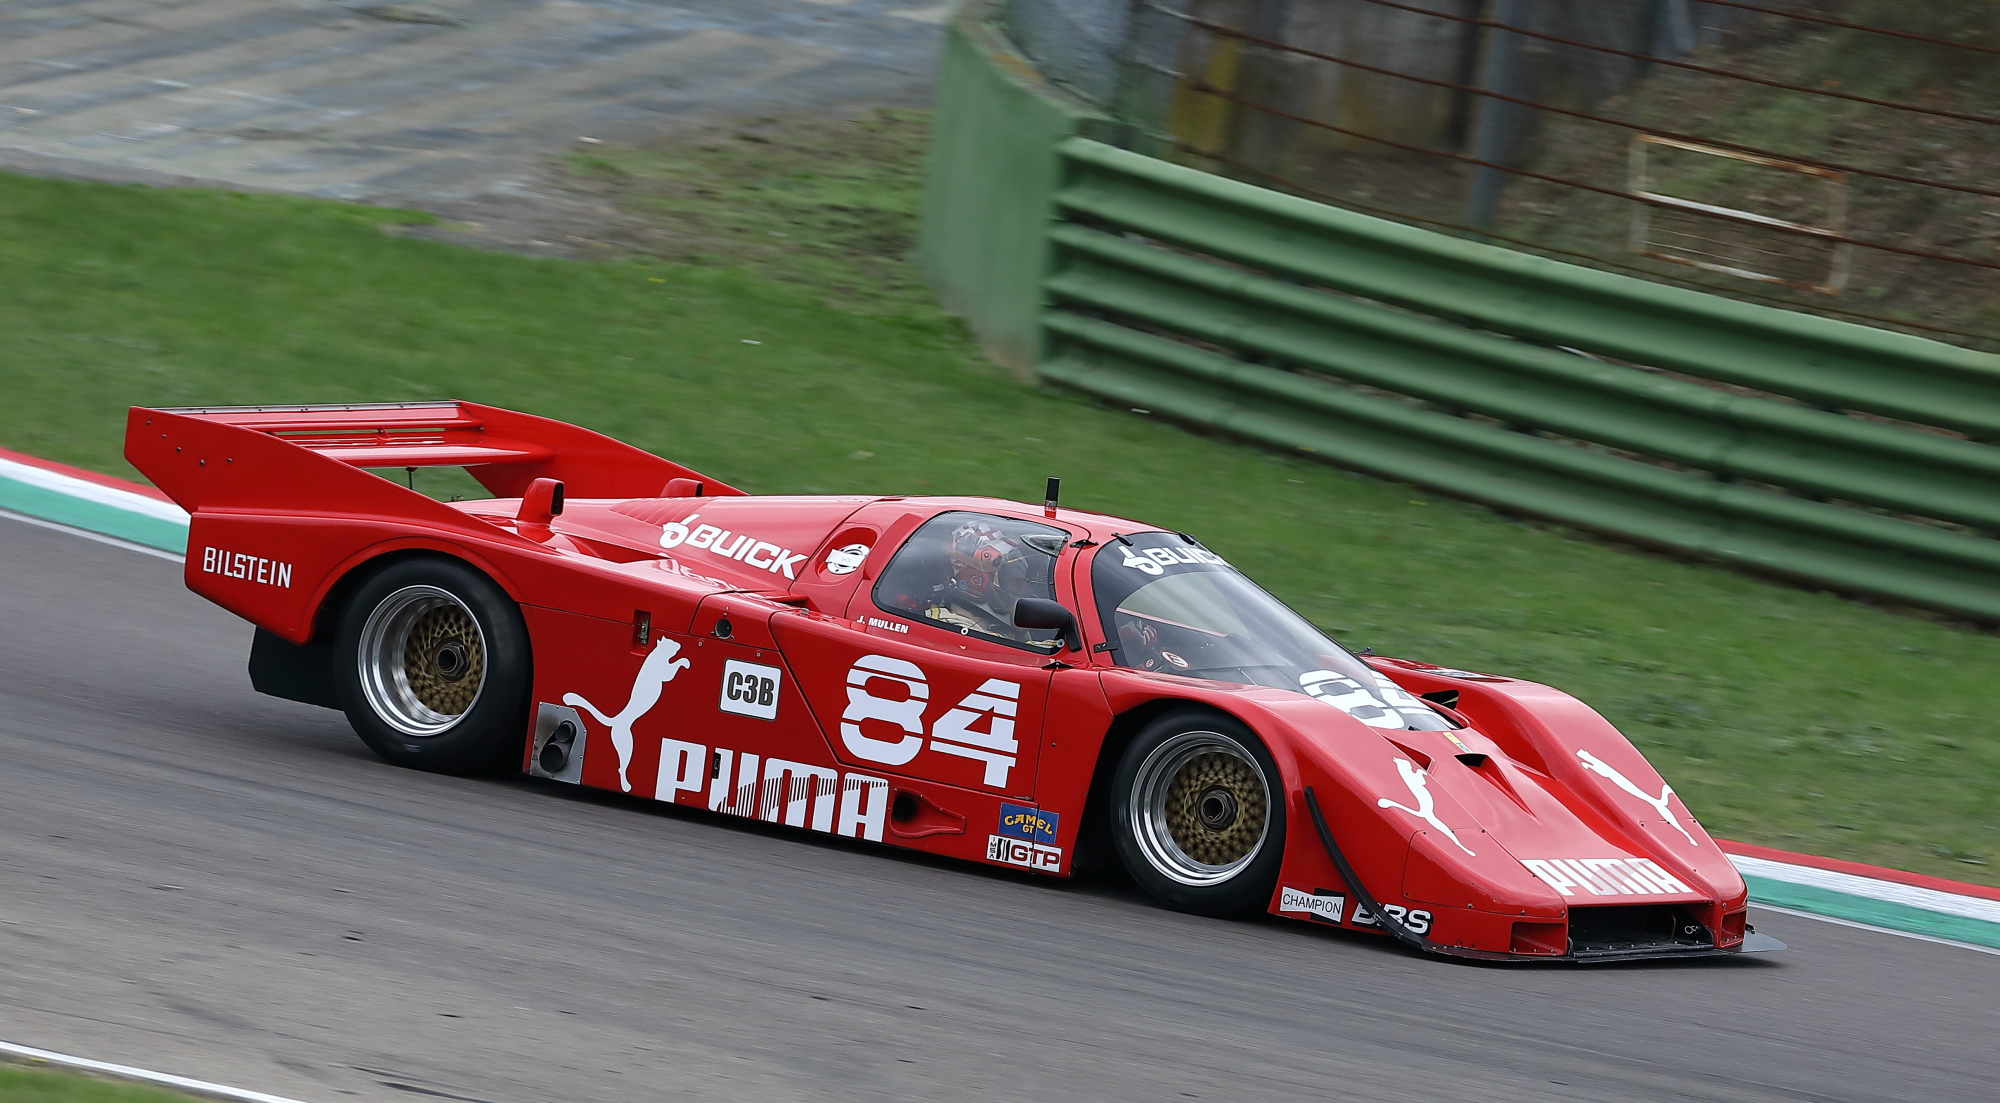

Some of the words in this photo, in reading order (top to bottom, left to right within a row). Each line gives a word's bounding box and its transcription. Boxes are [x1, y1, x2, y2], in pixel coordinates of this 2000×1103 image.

[203, 546, 292, 589] BILSTEIN
[685, 523, 809, 581] BUICK
[856, 615, 866, 625] J.
[868, 617, 909, 634] MULLEN
[727, 671, 775, 706] C3B
[839, 654, 1021, 789] 84
[654, 737, 889, 843] PUMA
[1004, 814, 1053, 835] CAMEL
[1022, 824, 1034, 833] GT
[1010, 844, 1060, 867] GTP
[1519, 857, 1695, 896] PUMA
[1282, 893, 1342, 915] CHAMPION
